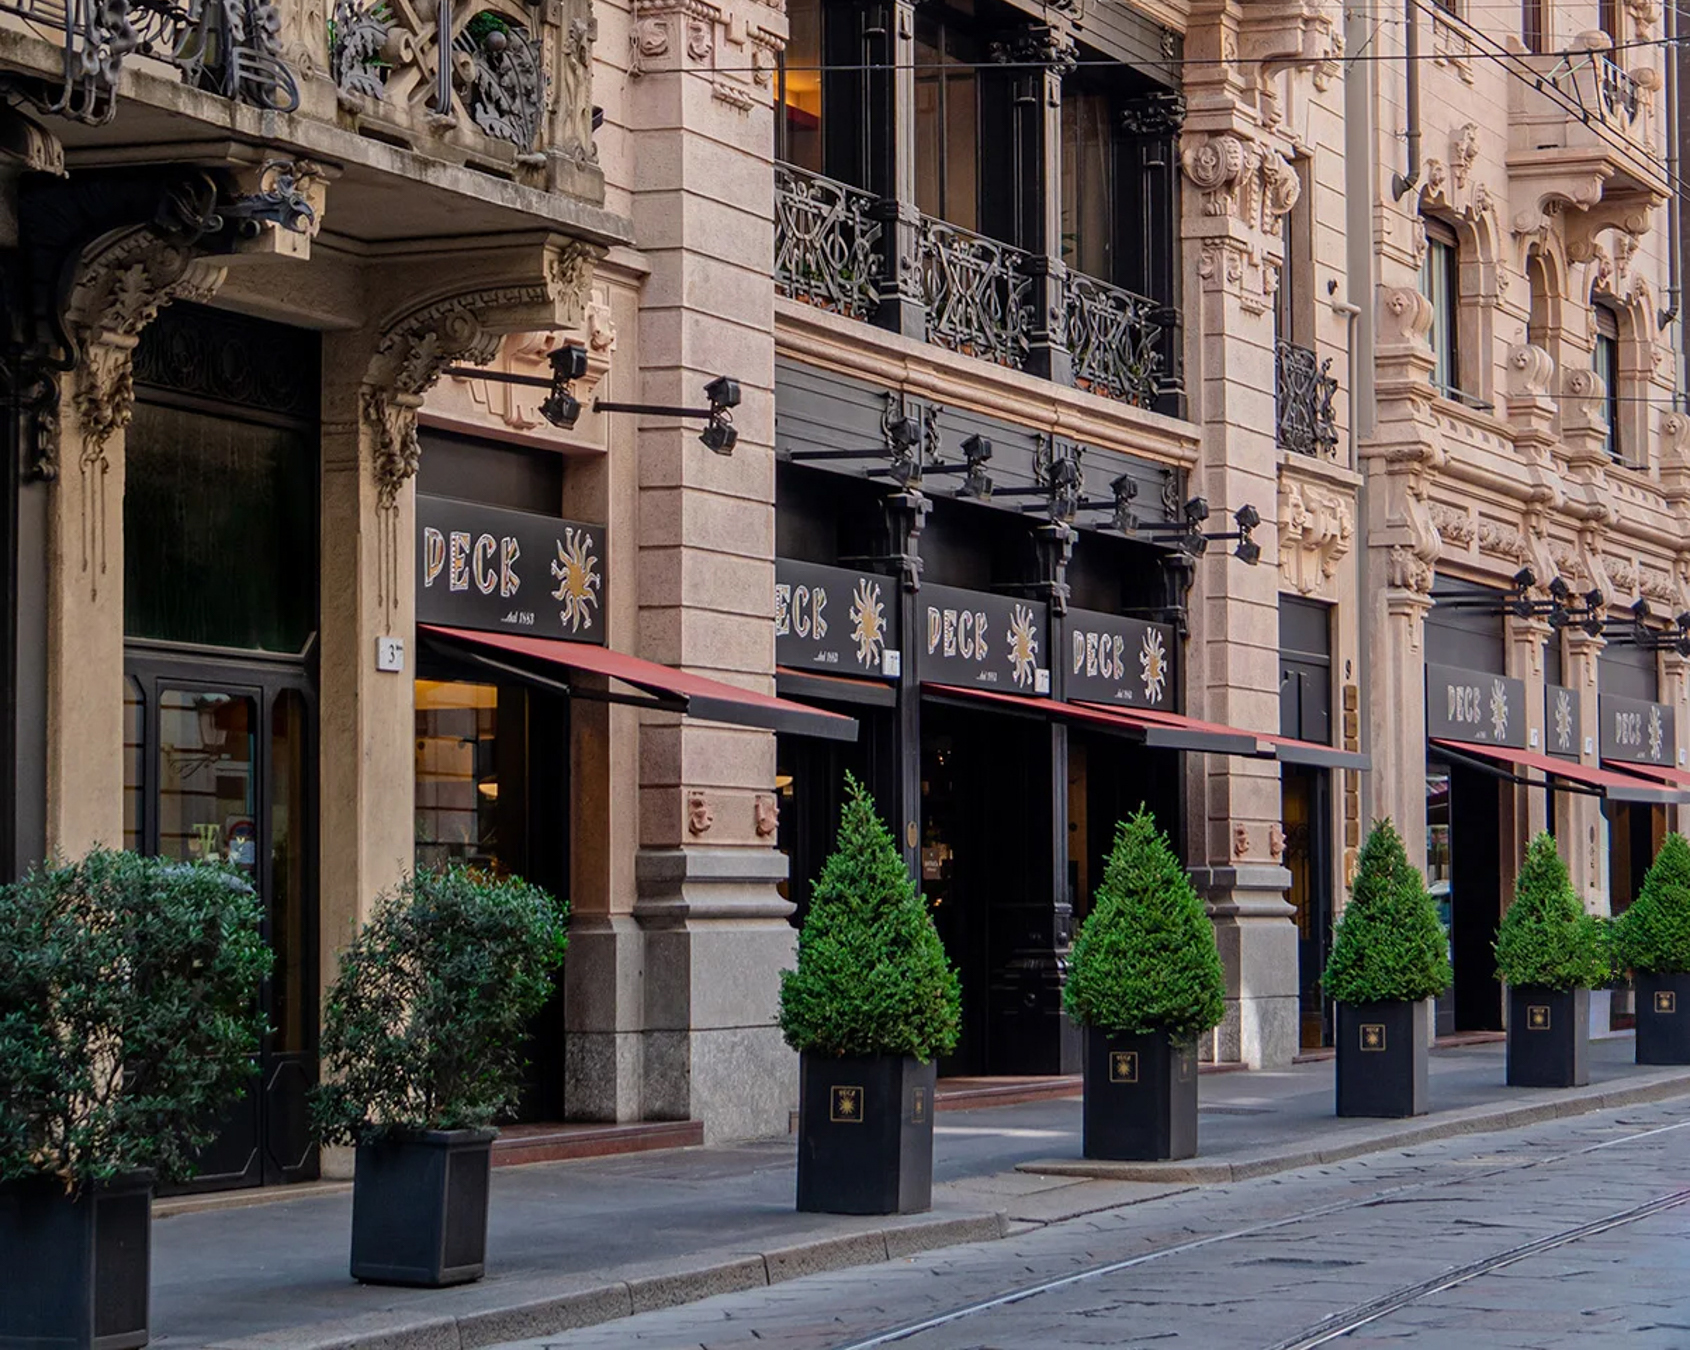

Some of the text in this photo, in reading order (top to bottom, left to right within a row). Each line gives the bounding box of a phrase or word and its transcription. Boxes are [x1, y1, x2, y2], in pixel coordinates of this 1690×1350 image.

[424, 526, 520, 598] PECK
[775, 583, 828, 640] ECK
[927, 606, 988, 661] PECK
[1073, 630, 1125, 680] PECK
